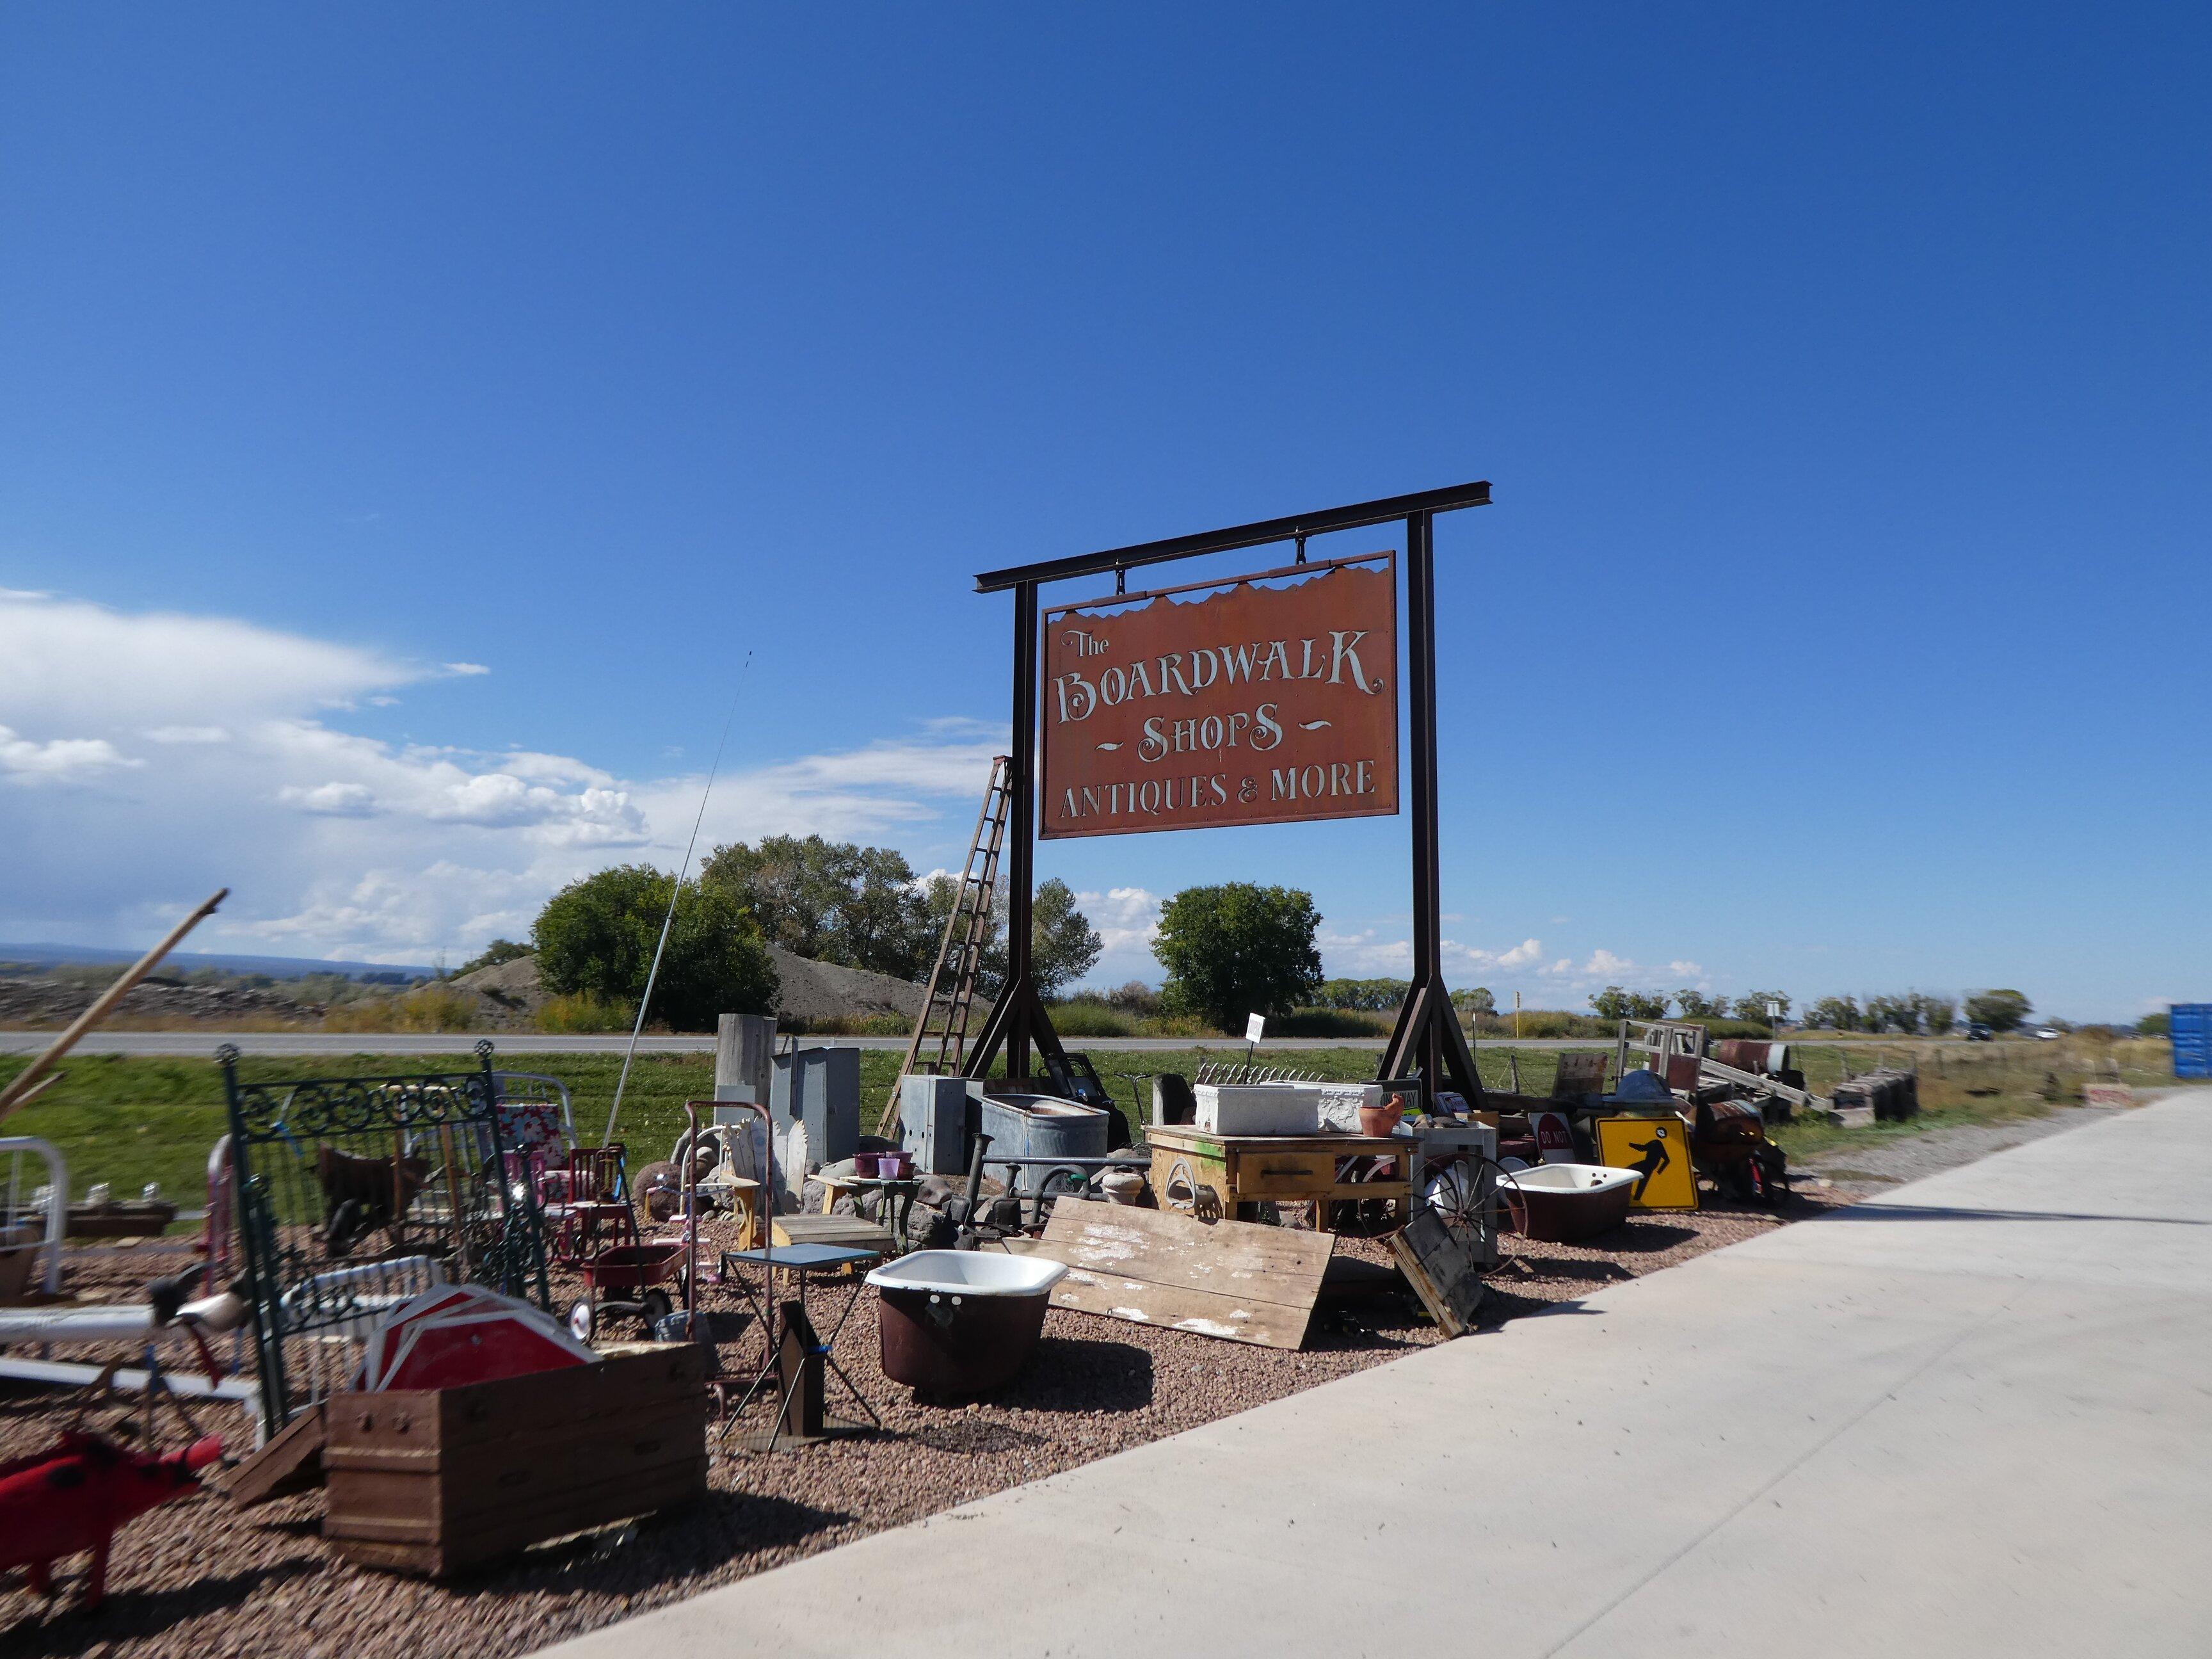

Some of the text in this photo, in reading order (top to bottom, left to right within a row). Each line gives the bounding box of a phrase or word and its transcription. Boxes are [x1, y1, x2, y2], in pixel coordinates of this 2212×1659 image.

[1061, 630, 1110, 657] The
[1053, 630, 1384, 725] BOARDWALK
[1137, 703, 1283, 762] SHOPS
[1058, 758, 1375, 818] ANTIQUES & MORE
[1540, 1130, 1568, 1144] DO NOT
